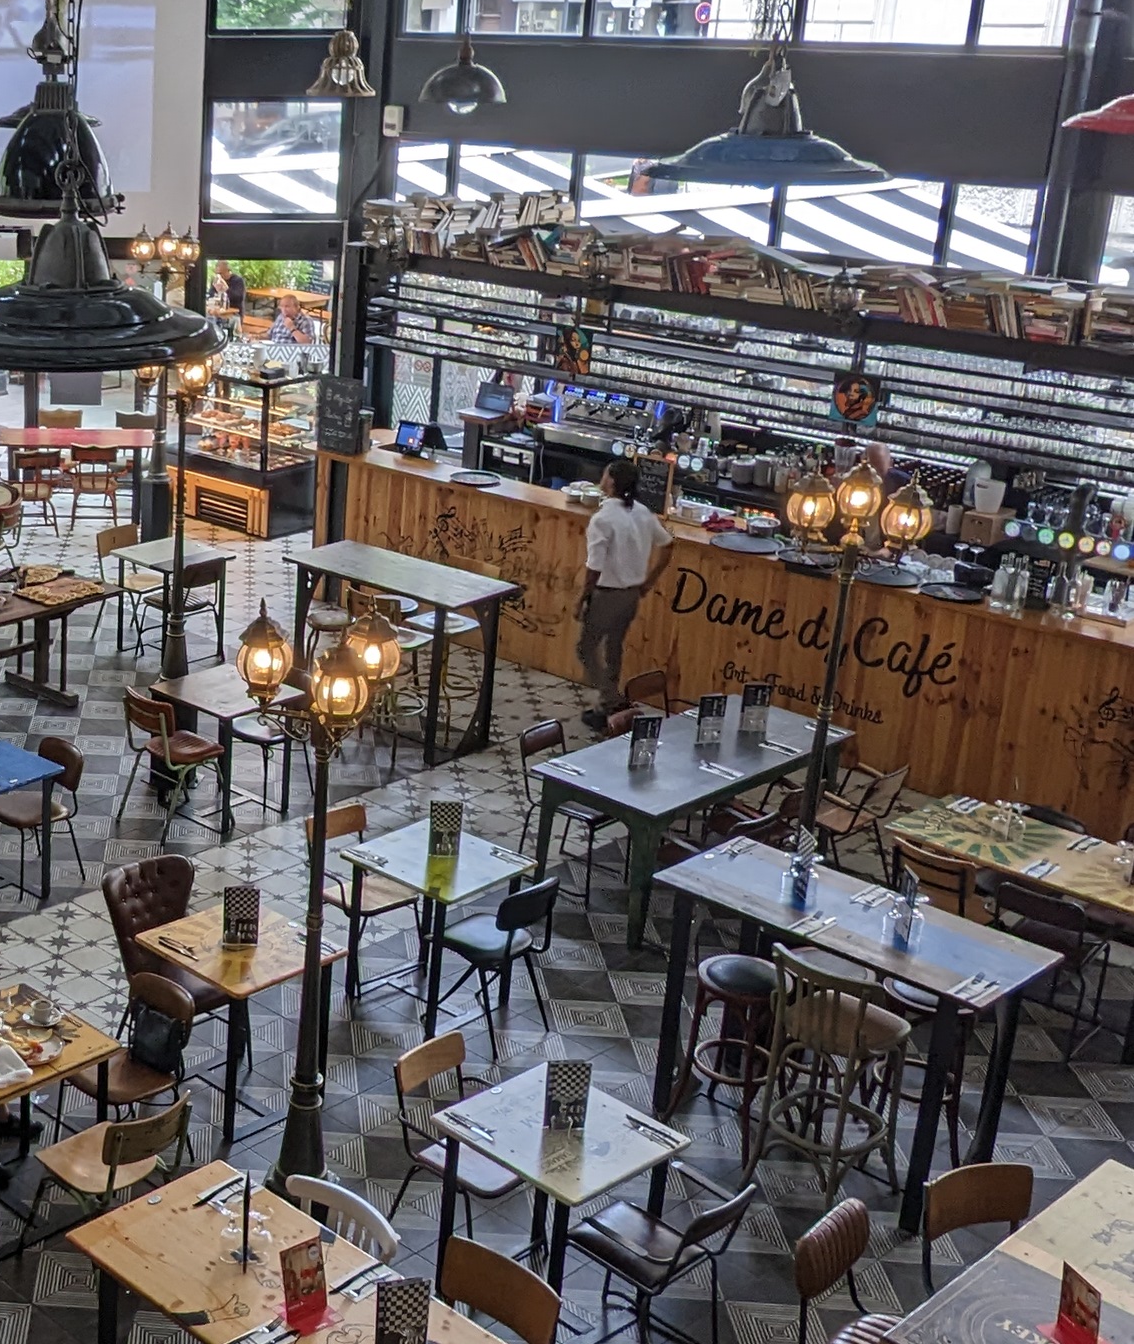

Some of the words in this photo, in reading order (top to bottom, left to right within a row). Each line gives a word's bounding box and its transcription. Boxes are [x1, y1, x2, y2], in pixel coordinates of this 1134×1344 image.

[670, 567, 789, 640] Dame
[852, 616, 957, 698] Café
[722, 660, 751, 684] Art
[764, 672, 806, 703] Food
[831, 690, 884, 725] Drinks
